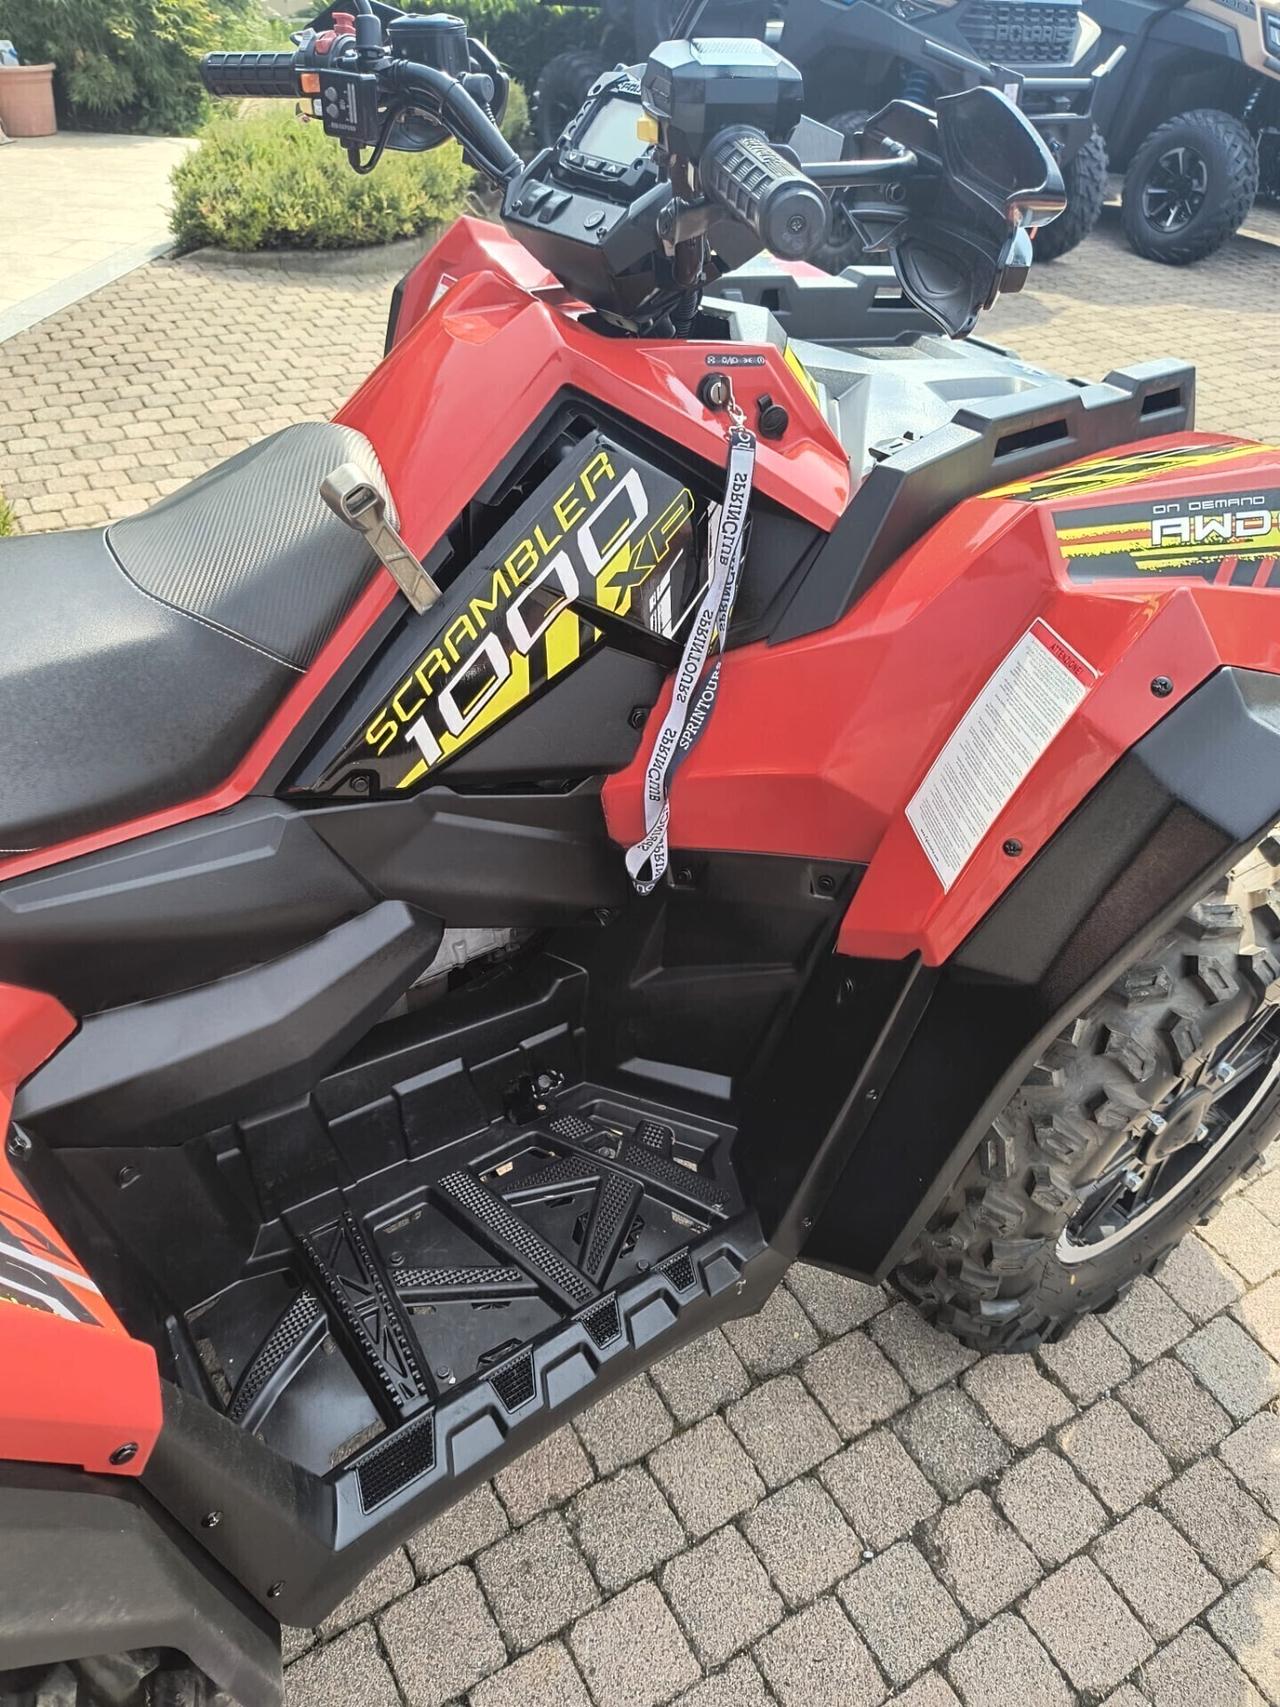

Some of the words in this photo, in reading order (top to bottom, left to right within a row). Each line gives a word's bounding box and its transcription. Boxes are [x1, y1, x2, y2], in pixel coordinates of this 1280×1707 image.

[996, 24, 1070, 43] POLARIS
[1151, 510, 1271, 546] AWD
[1153, 504, 1180, 514] ON
[1188, 496, 1265, 510] DEMAND
[604, 488, 695, 612] XP
[365, 452, 616, 756] SCRAMBLER
[404, 468, 649, 767] 1000
[680, 661, 721, 750] SPRINTOURS
